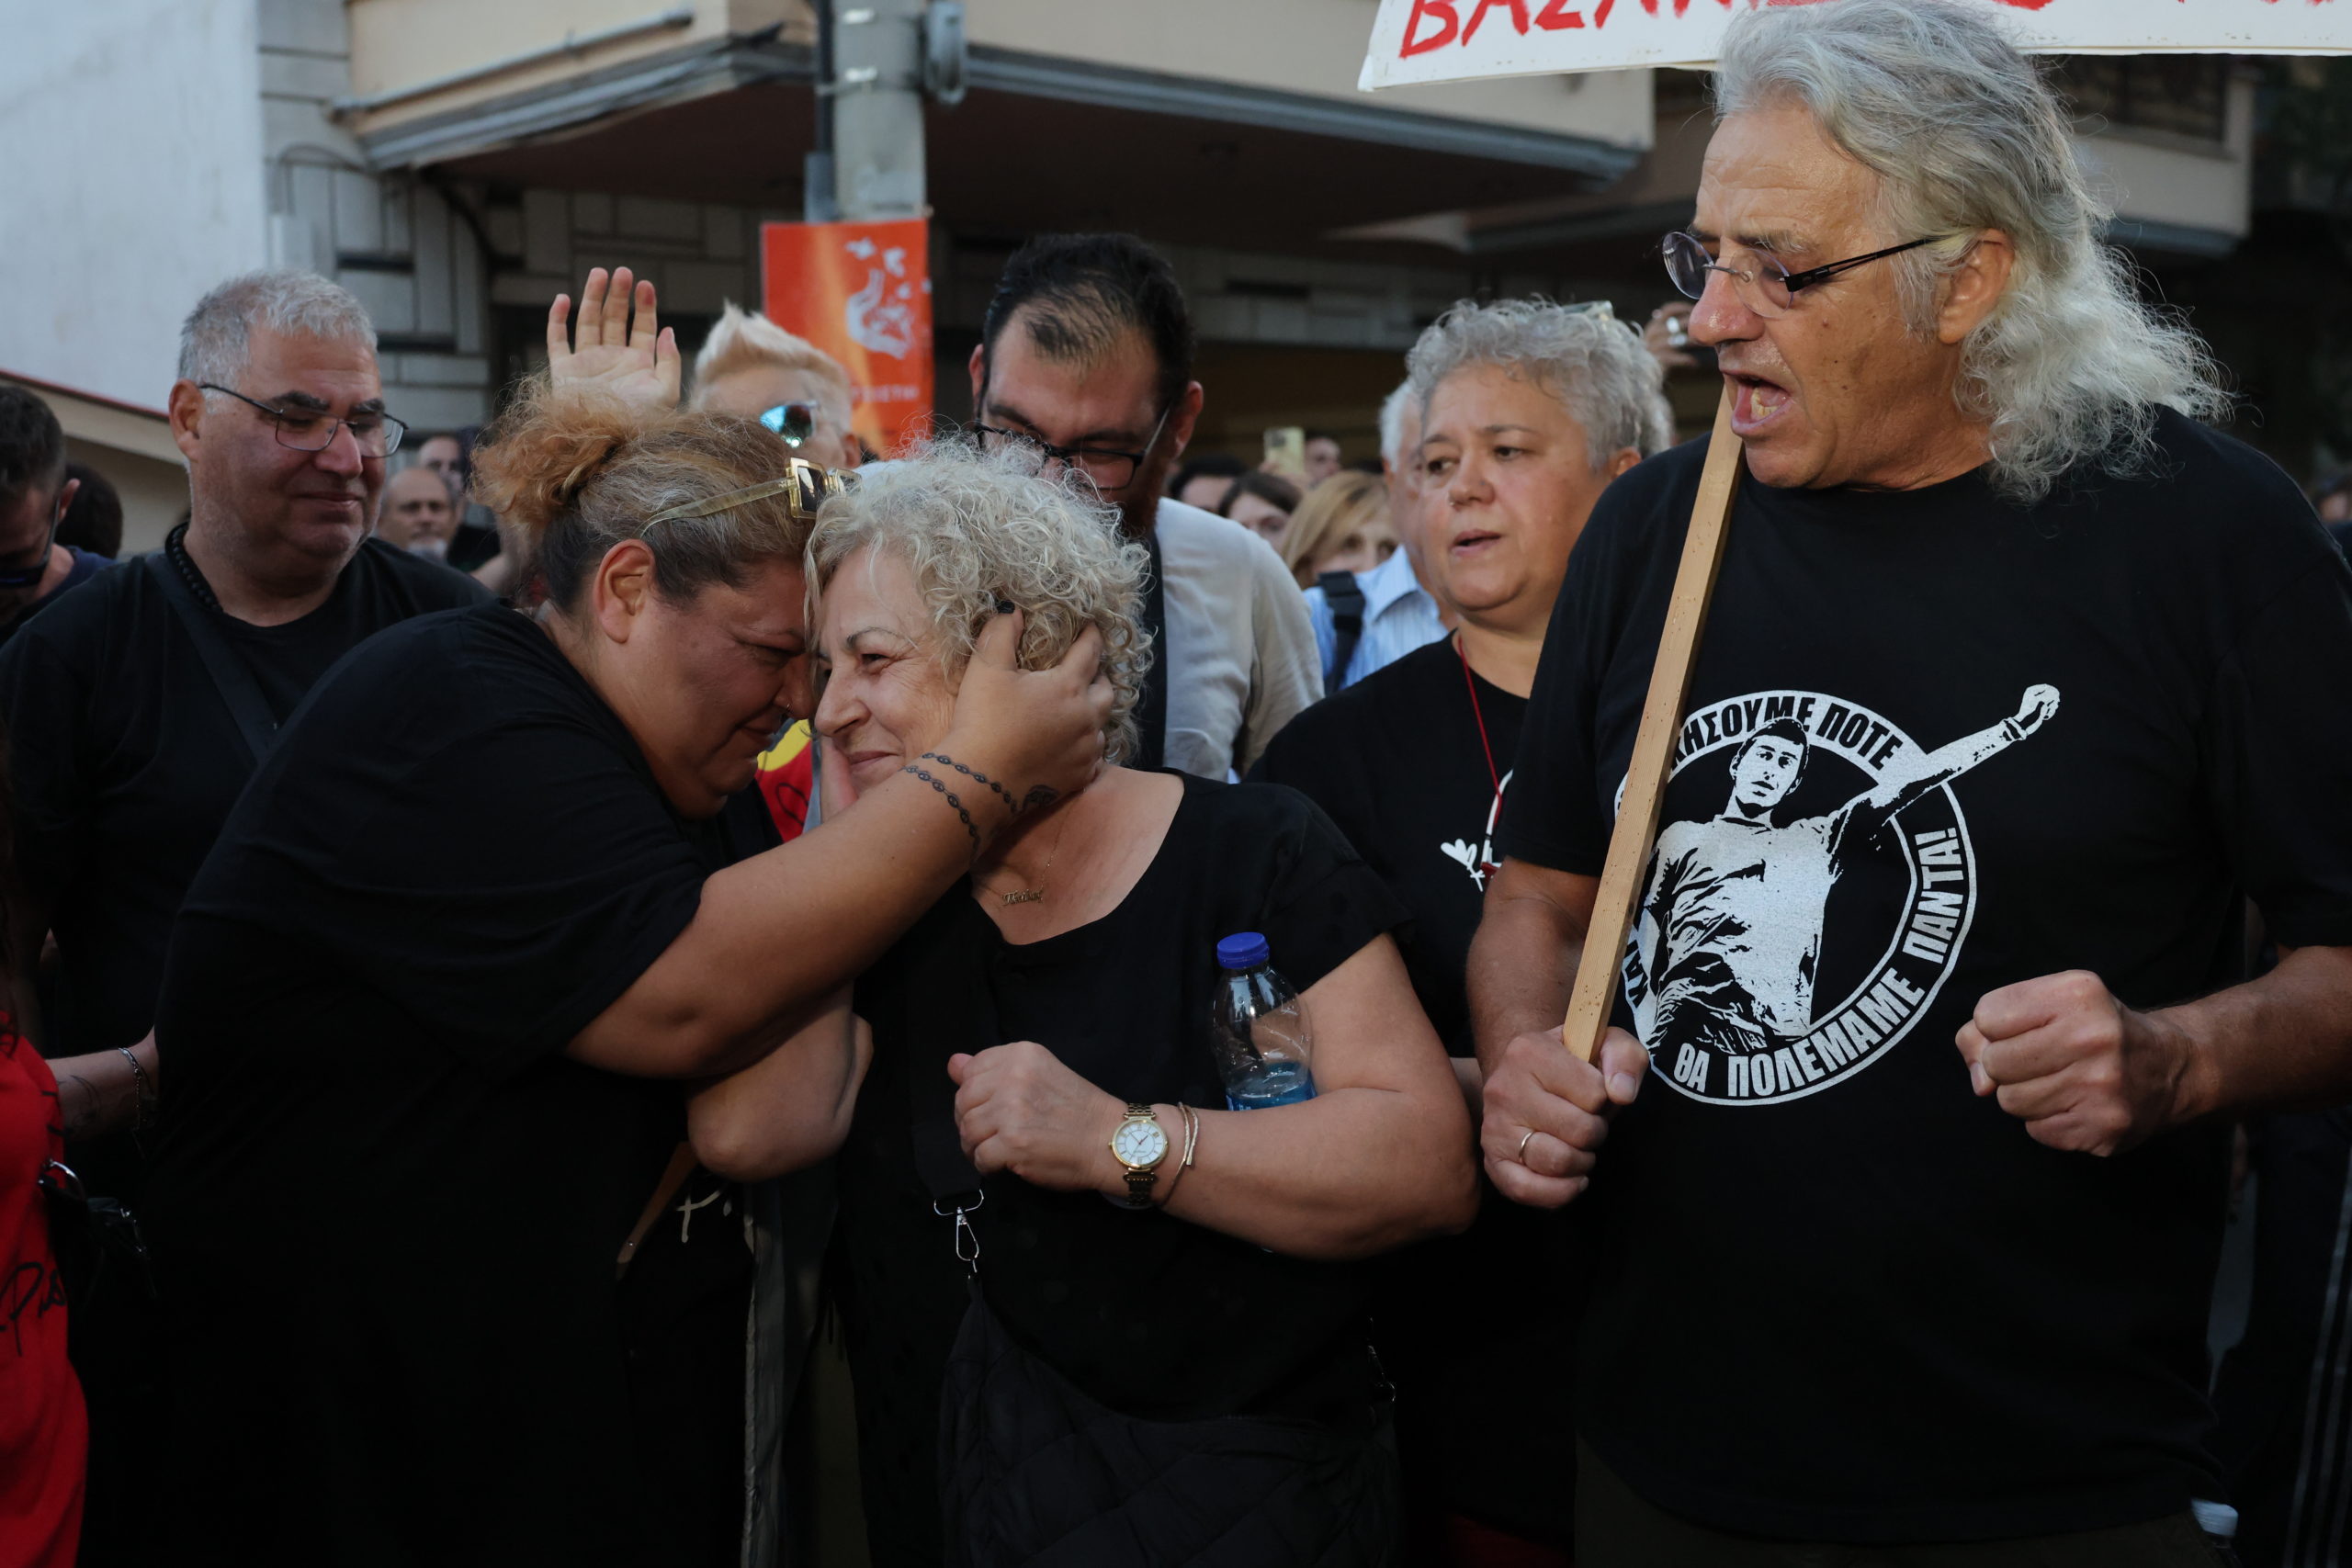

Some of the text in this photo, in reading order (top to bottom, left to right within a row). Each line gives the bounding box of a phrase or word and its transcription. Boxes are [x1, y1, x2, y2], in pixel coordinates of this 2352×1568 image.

[1815, 703, 1904, 771] ΠΟΤΕ
[1673, 827, 1965, 1097] ΘΑ ΠΟΛΕΜΑΜΕ ΠΑΝΤΑ!
